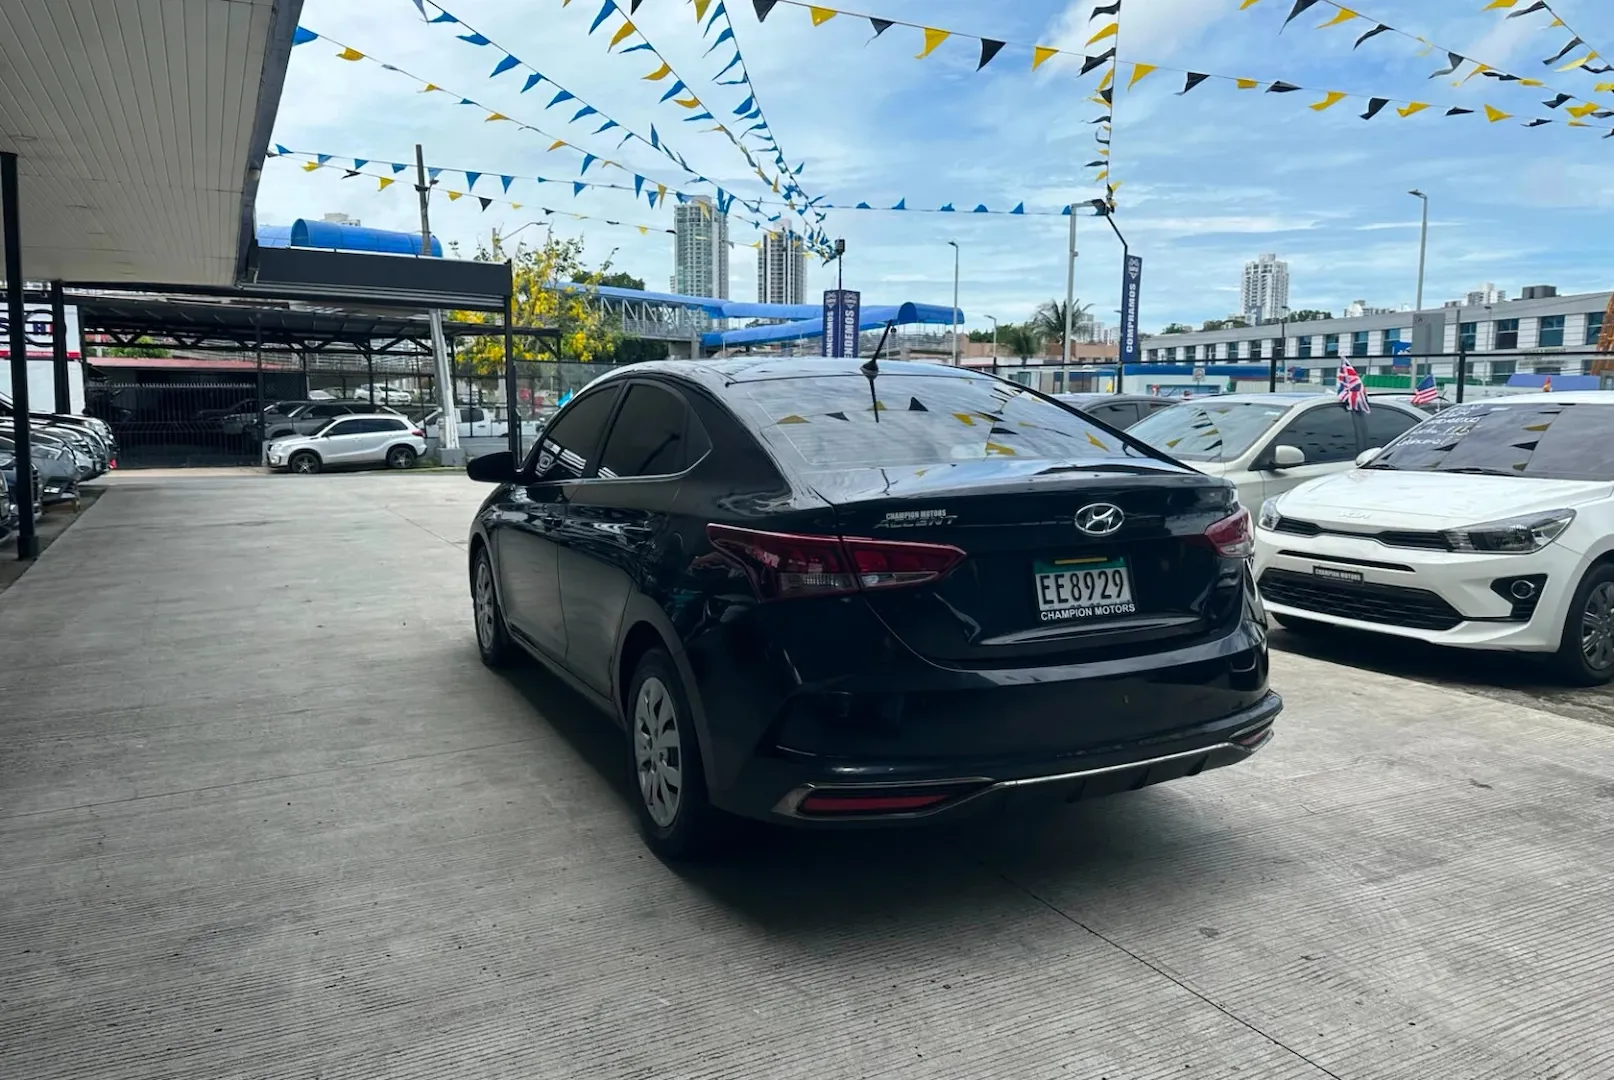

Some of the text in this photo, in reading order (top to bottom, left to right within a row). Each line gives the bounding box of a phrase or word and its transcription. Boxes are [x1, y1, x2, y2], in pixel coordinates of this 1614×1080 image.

[825, 310, 834, 357] NANCIAMOS
[843, 310, 855, 358] ENDEMOS
[1125, 283, 1137, 354] COMPRAMOS
[872, 514, 958, 529] ACCENT
[885, 509, 947, 520] CHAMPION MOTORS
[1039, 569, 1124, 605] EE8929
[1040, 607, 1093, 621] CHAMPION
[1094, 603, 1136, 616] MOTORS
